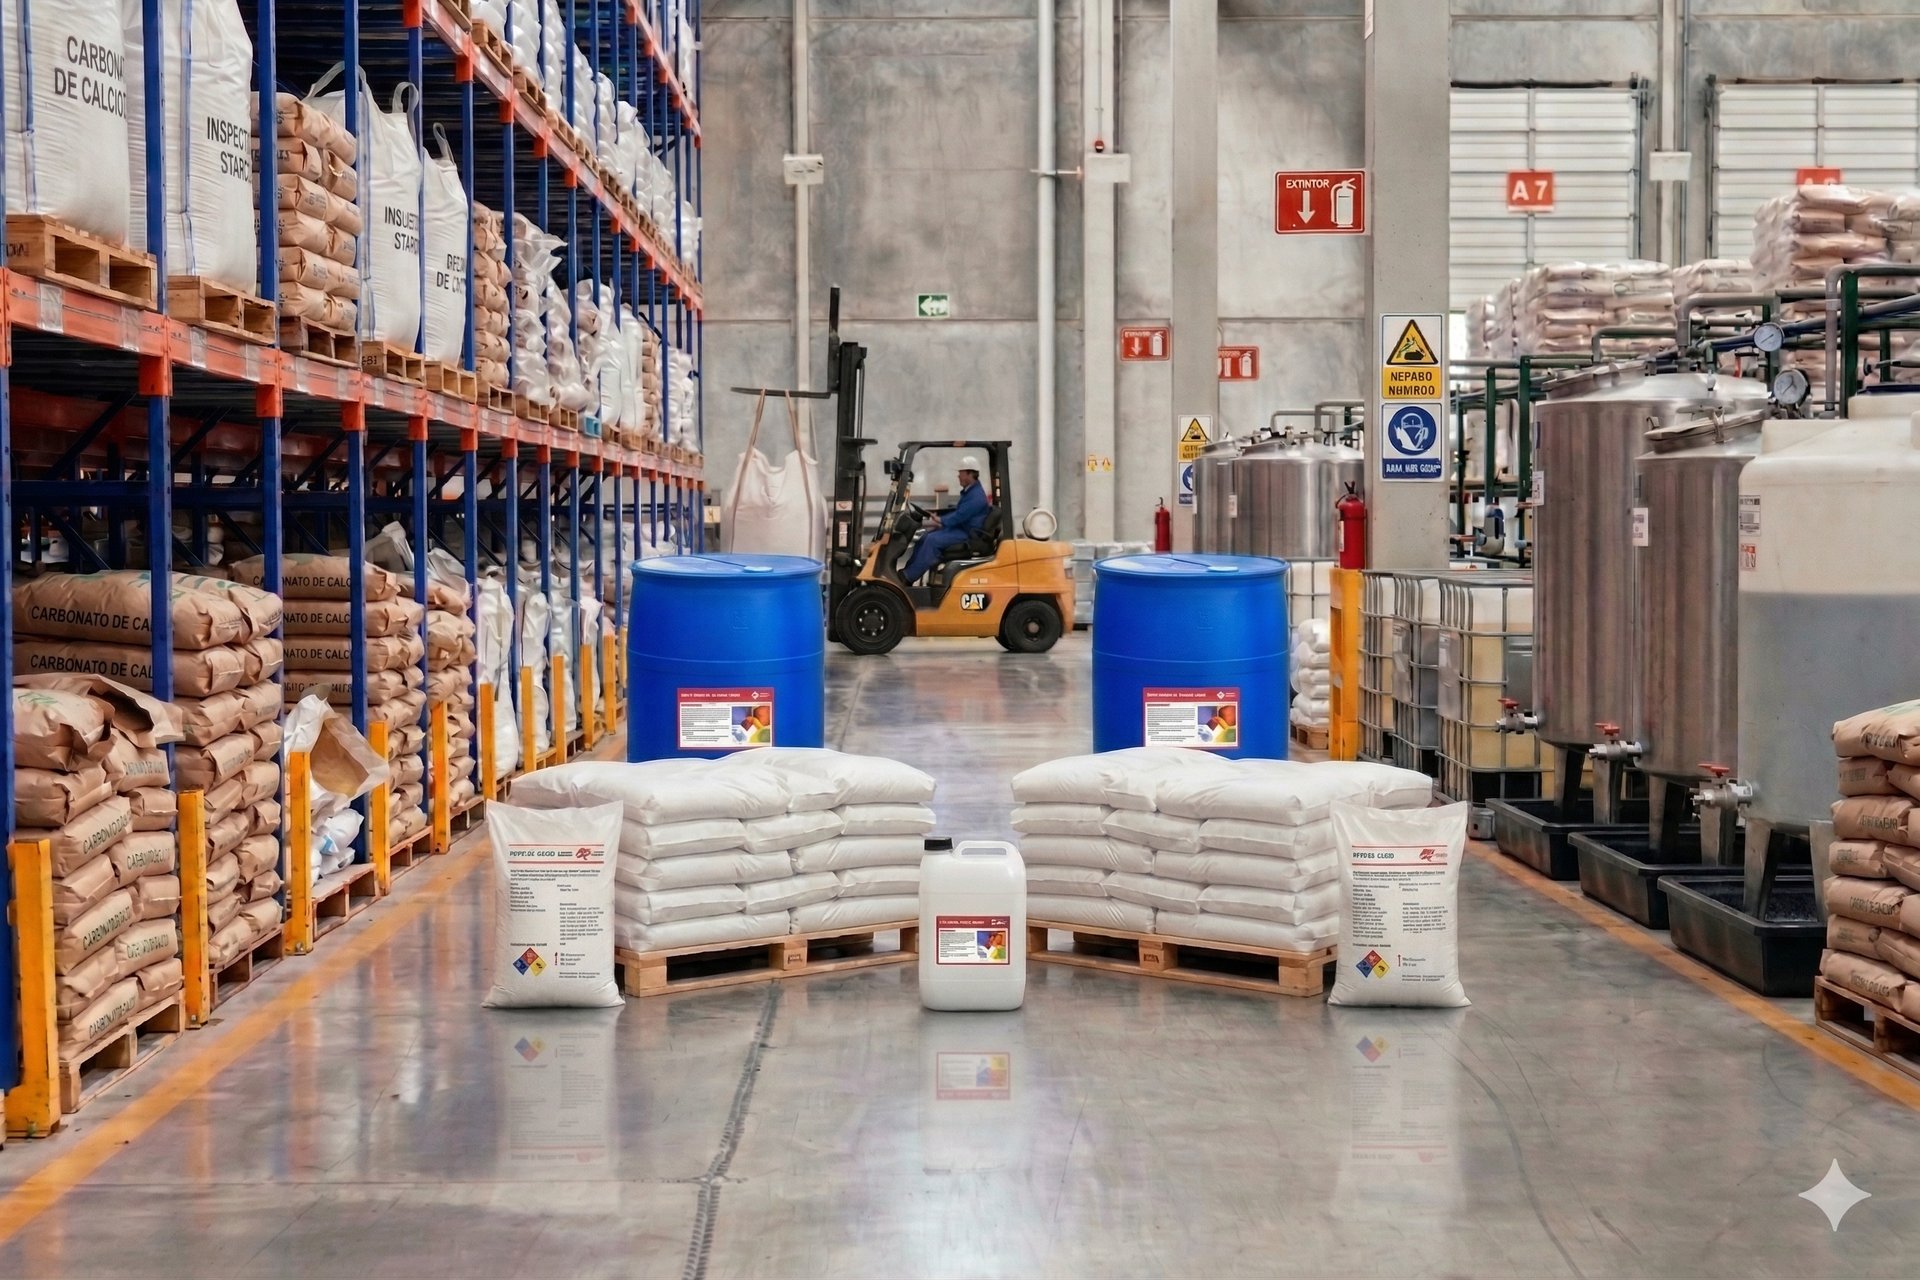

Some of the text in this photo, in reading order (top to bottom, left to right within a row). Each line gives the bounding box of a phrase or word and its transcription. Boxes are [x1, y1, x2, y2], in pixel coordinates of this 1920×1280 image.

[54, 67, 78, 100] DE
[1286, 179, 1330, 189] EXTINTOR
[1390, 371, 1432, 382] NEPABO
[312, 576, 325, 587] DE
[961, 593, 985, 610] CAT
[31, 605, 109, 628] CARBONATO
[112, 614, 129, 629] DE
[310, 612, 324, 624] DE
[310, 648, 323, 659] DE
[30, 654, 107, 675] CARBONATO
[110, 662, 127, 677] DE
